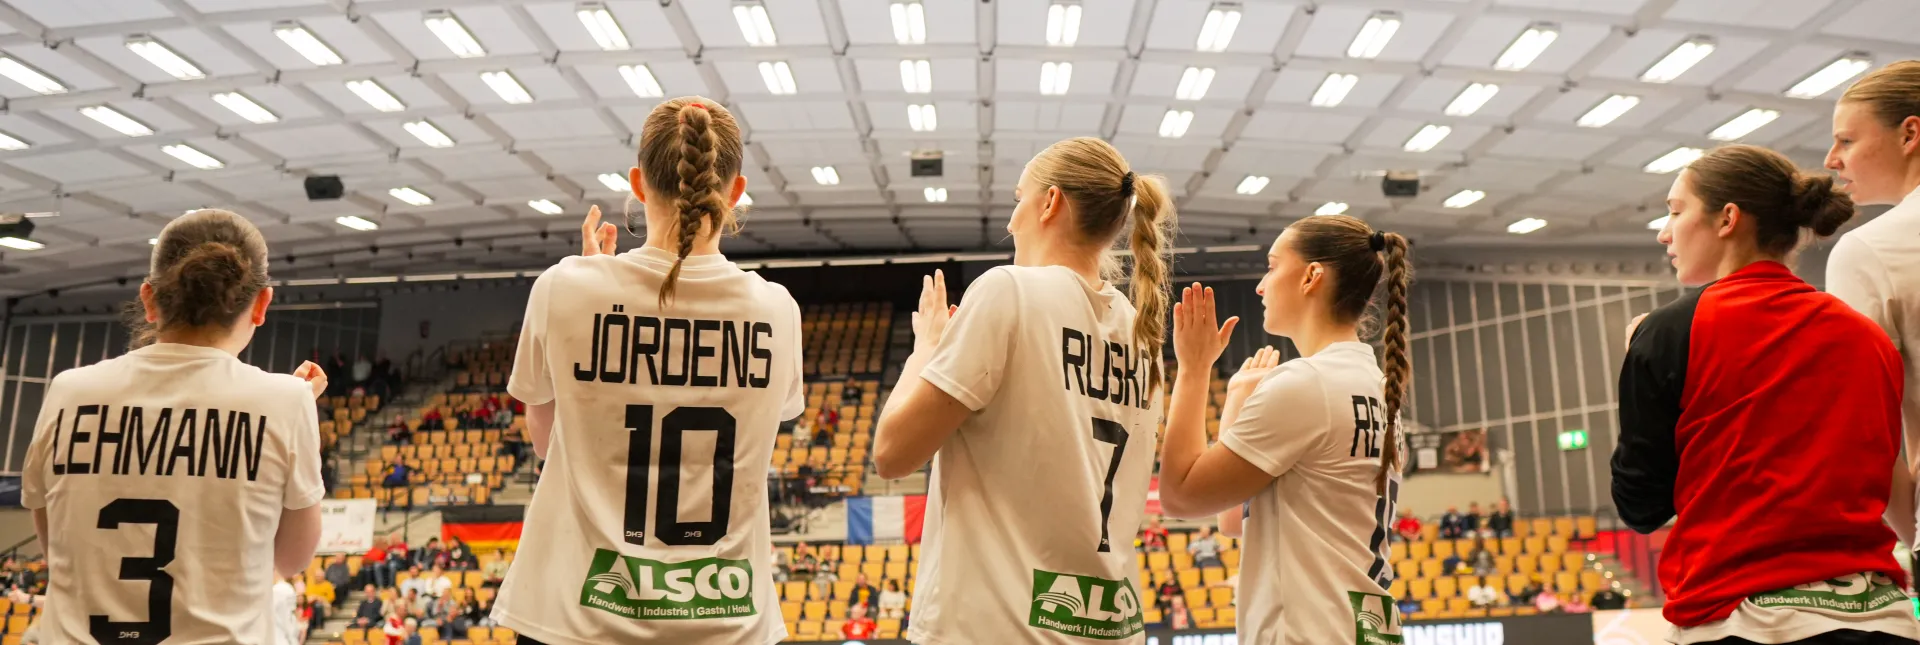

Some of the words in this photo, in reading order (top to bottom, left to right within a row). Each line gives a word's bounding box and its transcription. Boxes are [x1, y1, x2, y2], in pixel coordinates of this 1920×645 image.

[574, 305, 773, 388] JÖRDENS
[52, 404, 267, 481] LEHMANN
[624, 404, 736, 546] 10
[1092, 417, 1130, 553] 7
[89, 498, 180, 645] 3
[587, 554, 751, 602] ALSCO
[588, 595, 635, 615] Handwerk
[643, 607, 688, 616] Industrie
[1754, 596, 1811, 606] Handwerk
[1819, 597, 1862, 610] Industrie
[1868, 595, 1890, 608] astro
[1038, 616, 1081, 633] Handwerk
